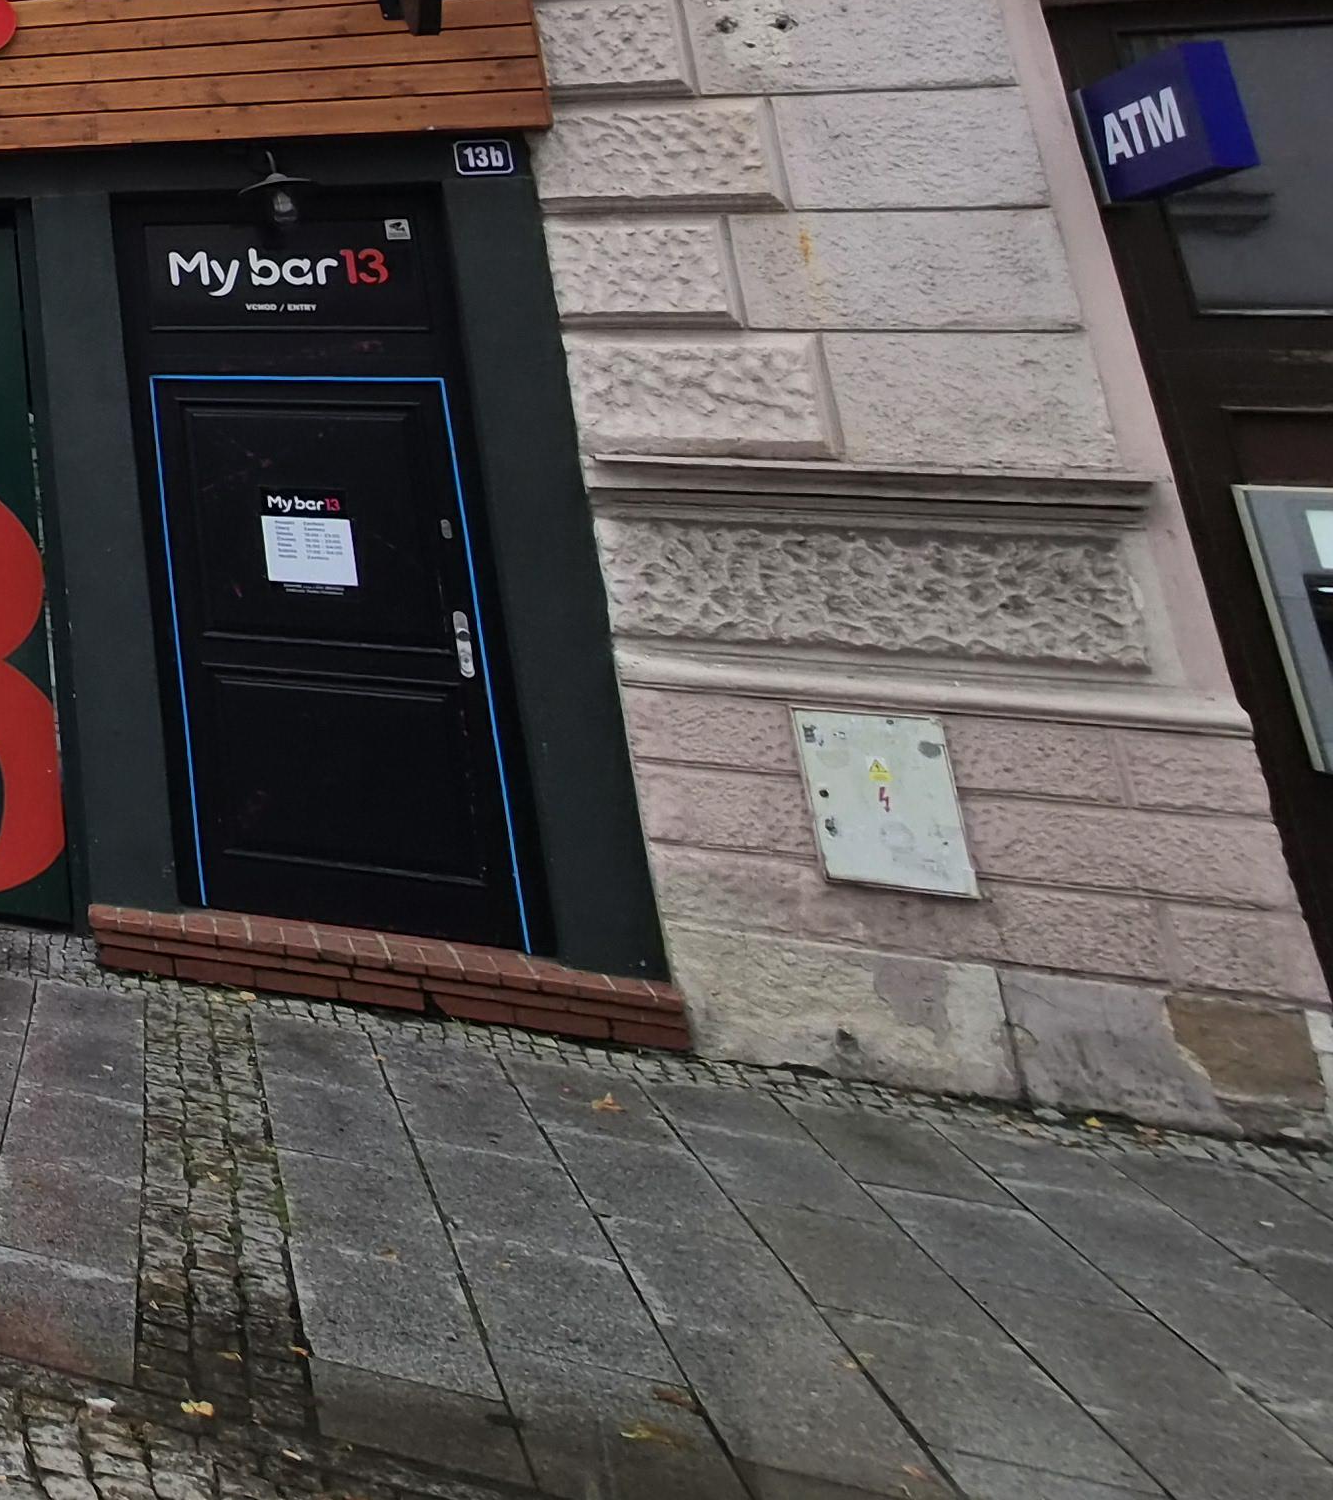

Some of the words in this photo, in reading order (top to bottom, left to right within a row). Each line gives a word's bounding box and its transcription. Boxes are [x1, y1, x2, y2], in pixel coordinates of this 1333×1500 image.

[1101, 86, 1187, 166] ATM
[463, 146, 504, 168] 13b
[168, 251, 240, 297] My
[267, 494, 293, 513] My
